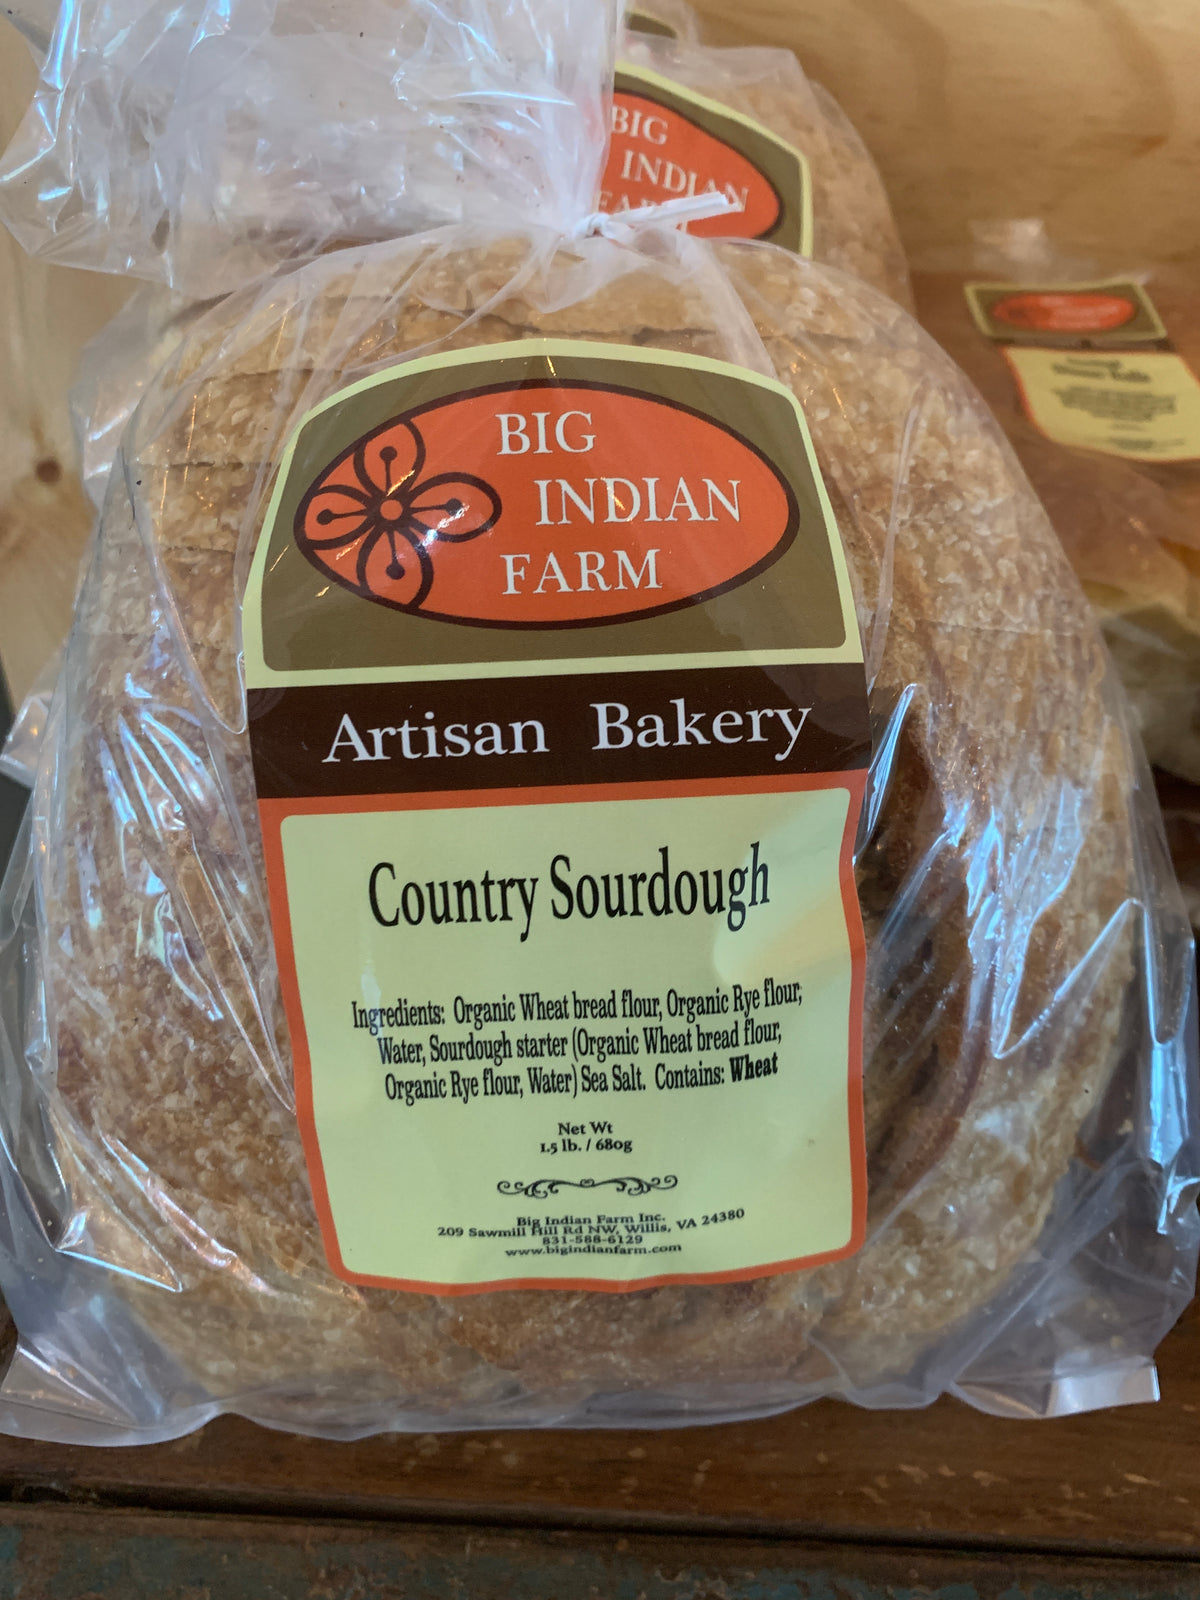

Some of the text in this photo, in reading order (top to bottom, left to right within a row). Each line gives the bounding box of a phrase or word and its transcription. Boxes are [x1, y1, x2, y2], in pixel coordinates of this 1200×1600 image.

[611, 106, 668, 145] BIG
[621, 150, 749, 212] INDIAN
[496, 410, 596, 456] BIG
[534, 477, 741, 526] INDIAN
[501, 550, 663, 595] FARM
[322, 698, 812, 764] Artisan Bakery
[368, 841, 770, 942] Country Sourdough
[352, 977, 802, 1036] Ingredients: Organic Wheat bread flour, Organic Rye flour,
[377, 1018, 782, 1067] Water, Sourdough starter (Organic Wheat bread flour,
[385, 1052, 778, 1106] Organic Rye flour, Water) Sea Salt. Contains: Wheat
[540, 1139, 632, 1155] 1.5 lb. / 680g
[558, 1121, 613, 1136] Net Wt
[438, 1208, 745, 1237] 209 Sawmill Hill Rd NW, Willis, VA 24380
[517, 1212, 665, 1228] Big Indian Farm Inc.
[505, 1244, 682, 1257] www.bigindianfarm.com
